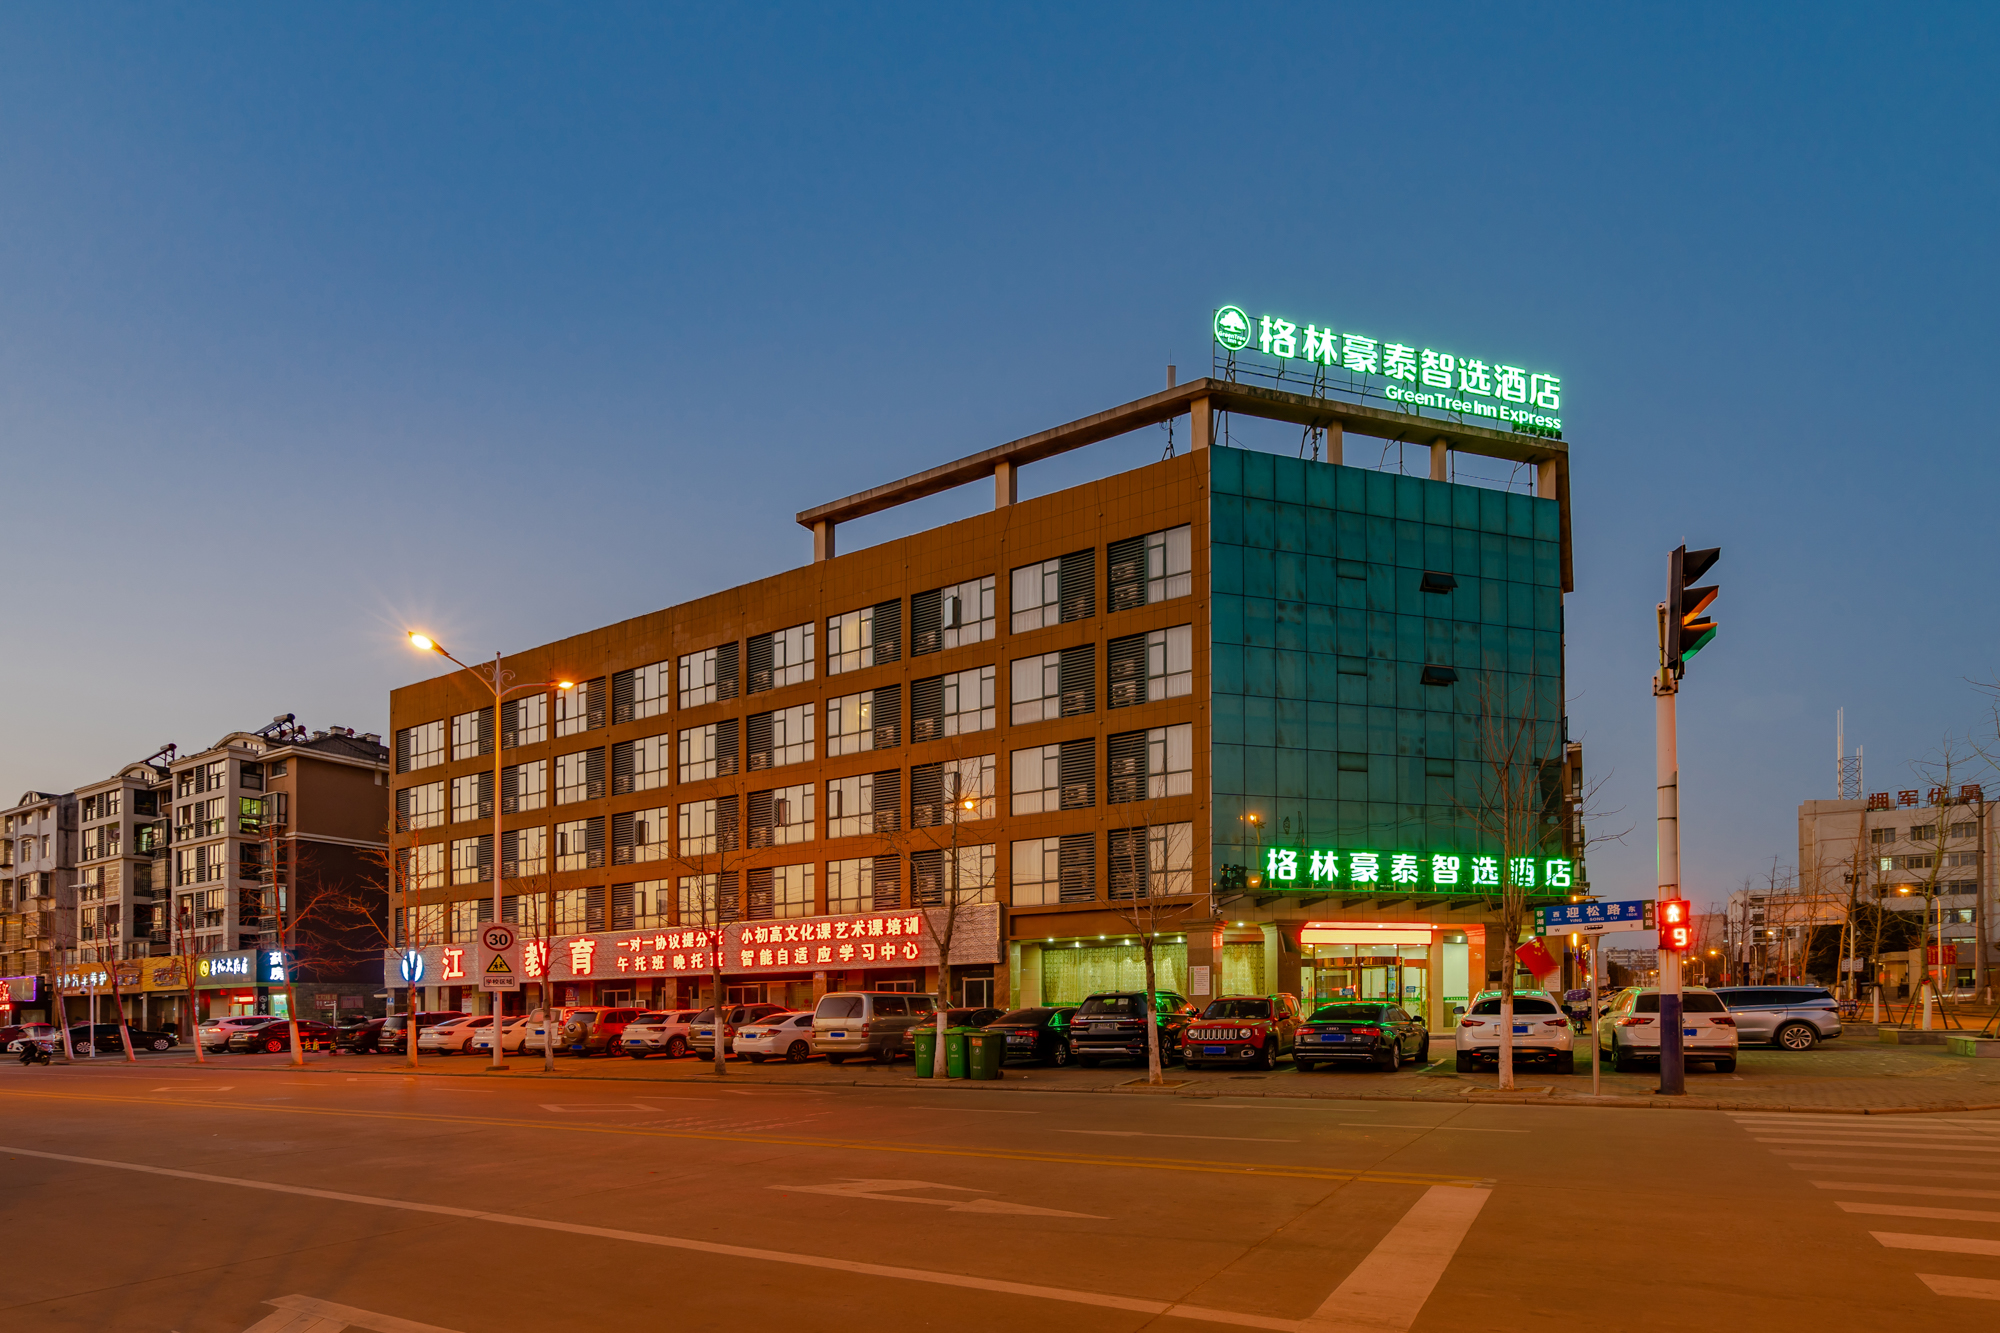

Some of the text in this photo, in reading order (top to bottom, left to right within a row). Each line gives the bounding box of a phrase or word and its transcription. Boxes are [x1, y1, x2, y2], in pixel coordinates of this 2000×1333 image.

[1259, 315, 1561, 410] 格林豪泰智选酒店
[1385, 384, 1562, 430] GreenTree Inn Express
[1267, 848, 1571, 887] 格林豪泰智选酒店
[1566, 903, 1621, 918] 迎松路
[1628, 905, 1636, 913] 东
[1645, 903, 1653, 926] 黄山路
[489, 933, 508, 946] 30
[741, 916, 919, 944] 小初高文化课艺术课培训
[1673, 927, 1687, 946] 9
[442, 938, 596, 981] 江教育
[740, 942, 919, 967] 智能自适应学习中心
